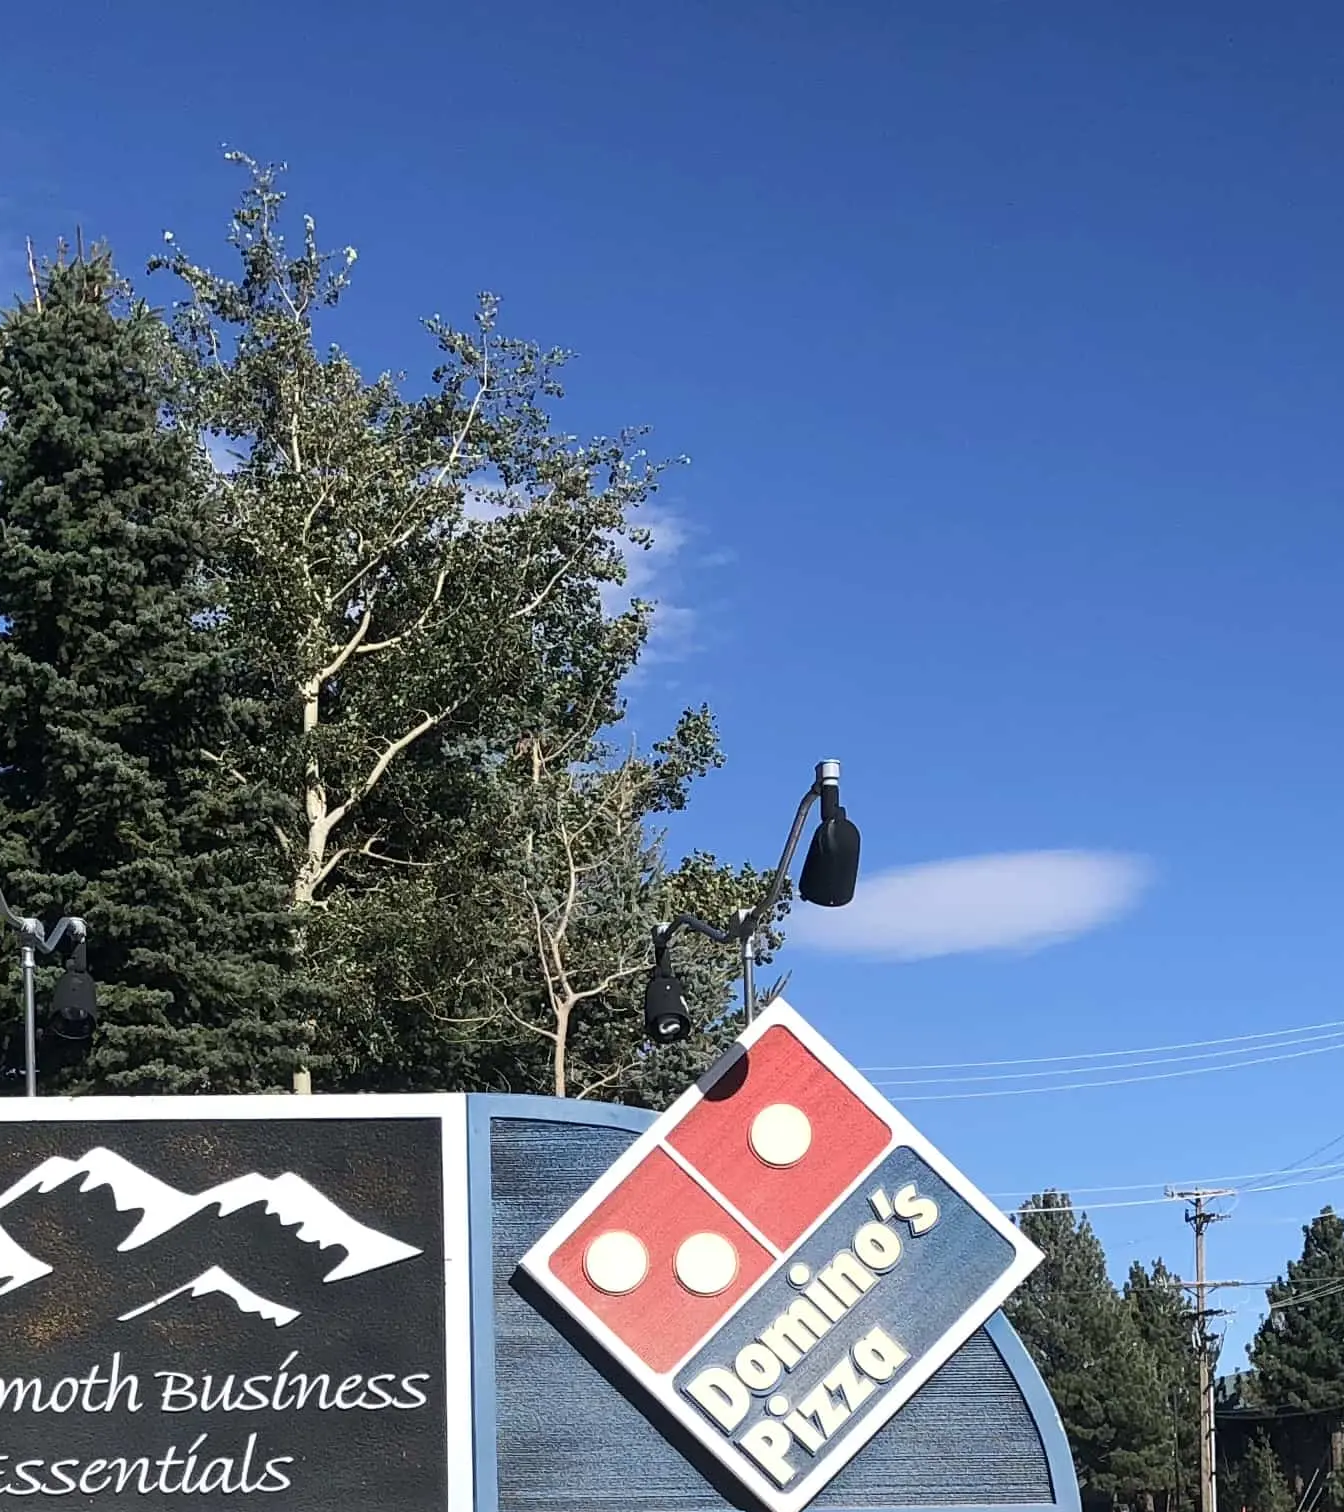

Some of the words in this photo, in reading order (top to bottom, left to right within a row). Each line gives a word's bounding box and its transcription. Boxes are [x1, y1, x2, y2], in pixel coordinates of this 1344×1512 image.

[154, 1350, 431, 1412] Business
[683, 1182, 940, 1436] Domino's
[734, 1326, 912, 1489] Pizza
